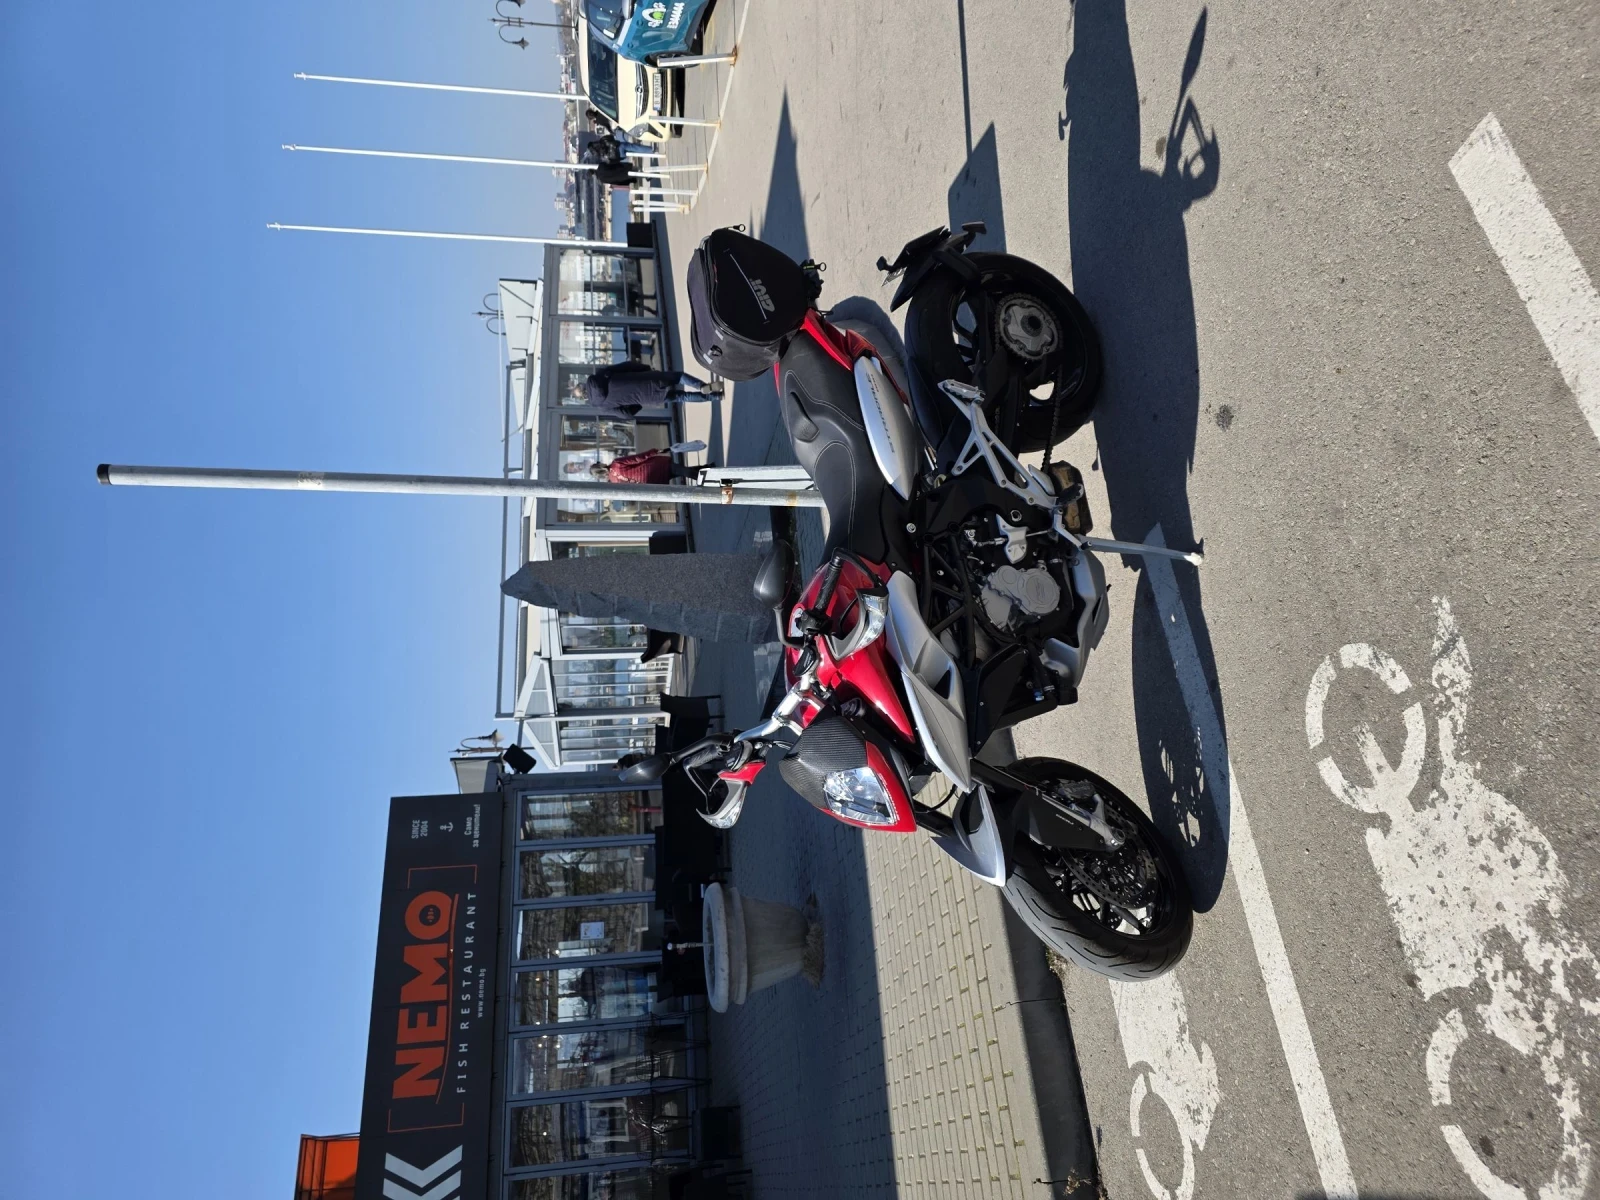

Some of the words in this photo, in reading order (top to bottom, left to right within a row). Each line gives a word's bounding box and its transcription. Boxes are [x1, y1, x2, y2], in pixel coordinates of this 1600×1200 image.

[749, 278, 776, 312] GIVI
[866, 372, 895, 453] STRADALE
[411, 820, 420, 839] SINCE
[420, 820, 428, 837] 2004
[464, 817, 473, 835] Само
[472, 840, 479, 848] за
[460, 893, 477, 1030] RESTAURANT
[392, 890, 453, 1099] NEMO
[477, 968, 487, 1018] www.nemo.bg
[456, 1043, 469, 1093] FISH
